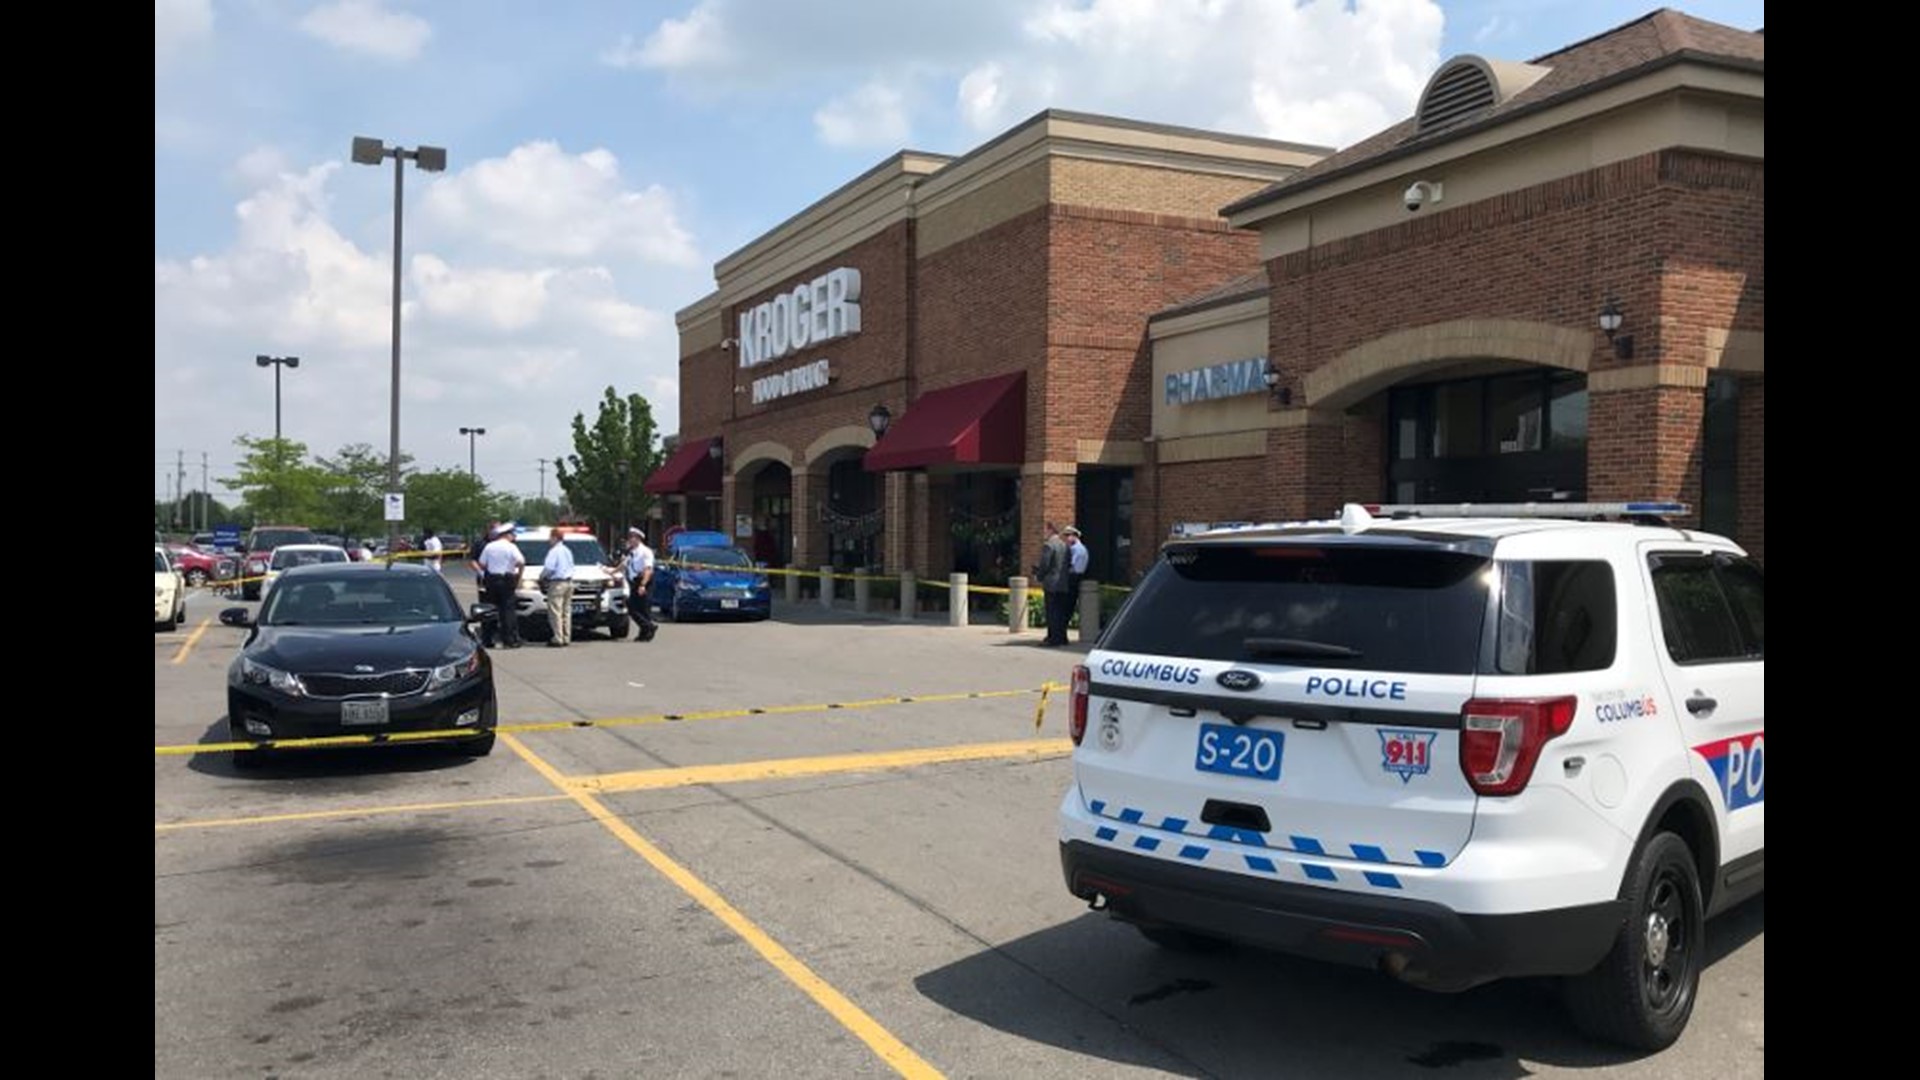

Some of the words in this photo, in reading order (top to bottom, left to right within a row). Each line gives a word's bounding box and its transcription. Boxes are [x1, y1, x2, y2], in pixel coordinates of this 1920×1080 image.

[739, 266, 862, 368] KROGER
[1101, 658, 1200, 685] COLUMBUS
[1305, 676, 1407, 700] POLICE
[1595, 694, 1657, 723] COLUMBUS
[1200, 731, 1277, 773] S-20
